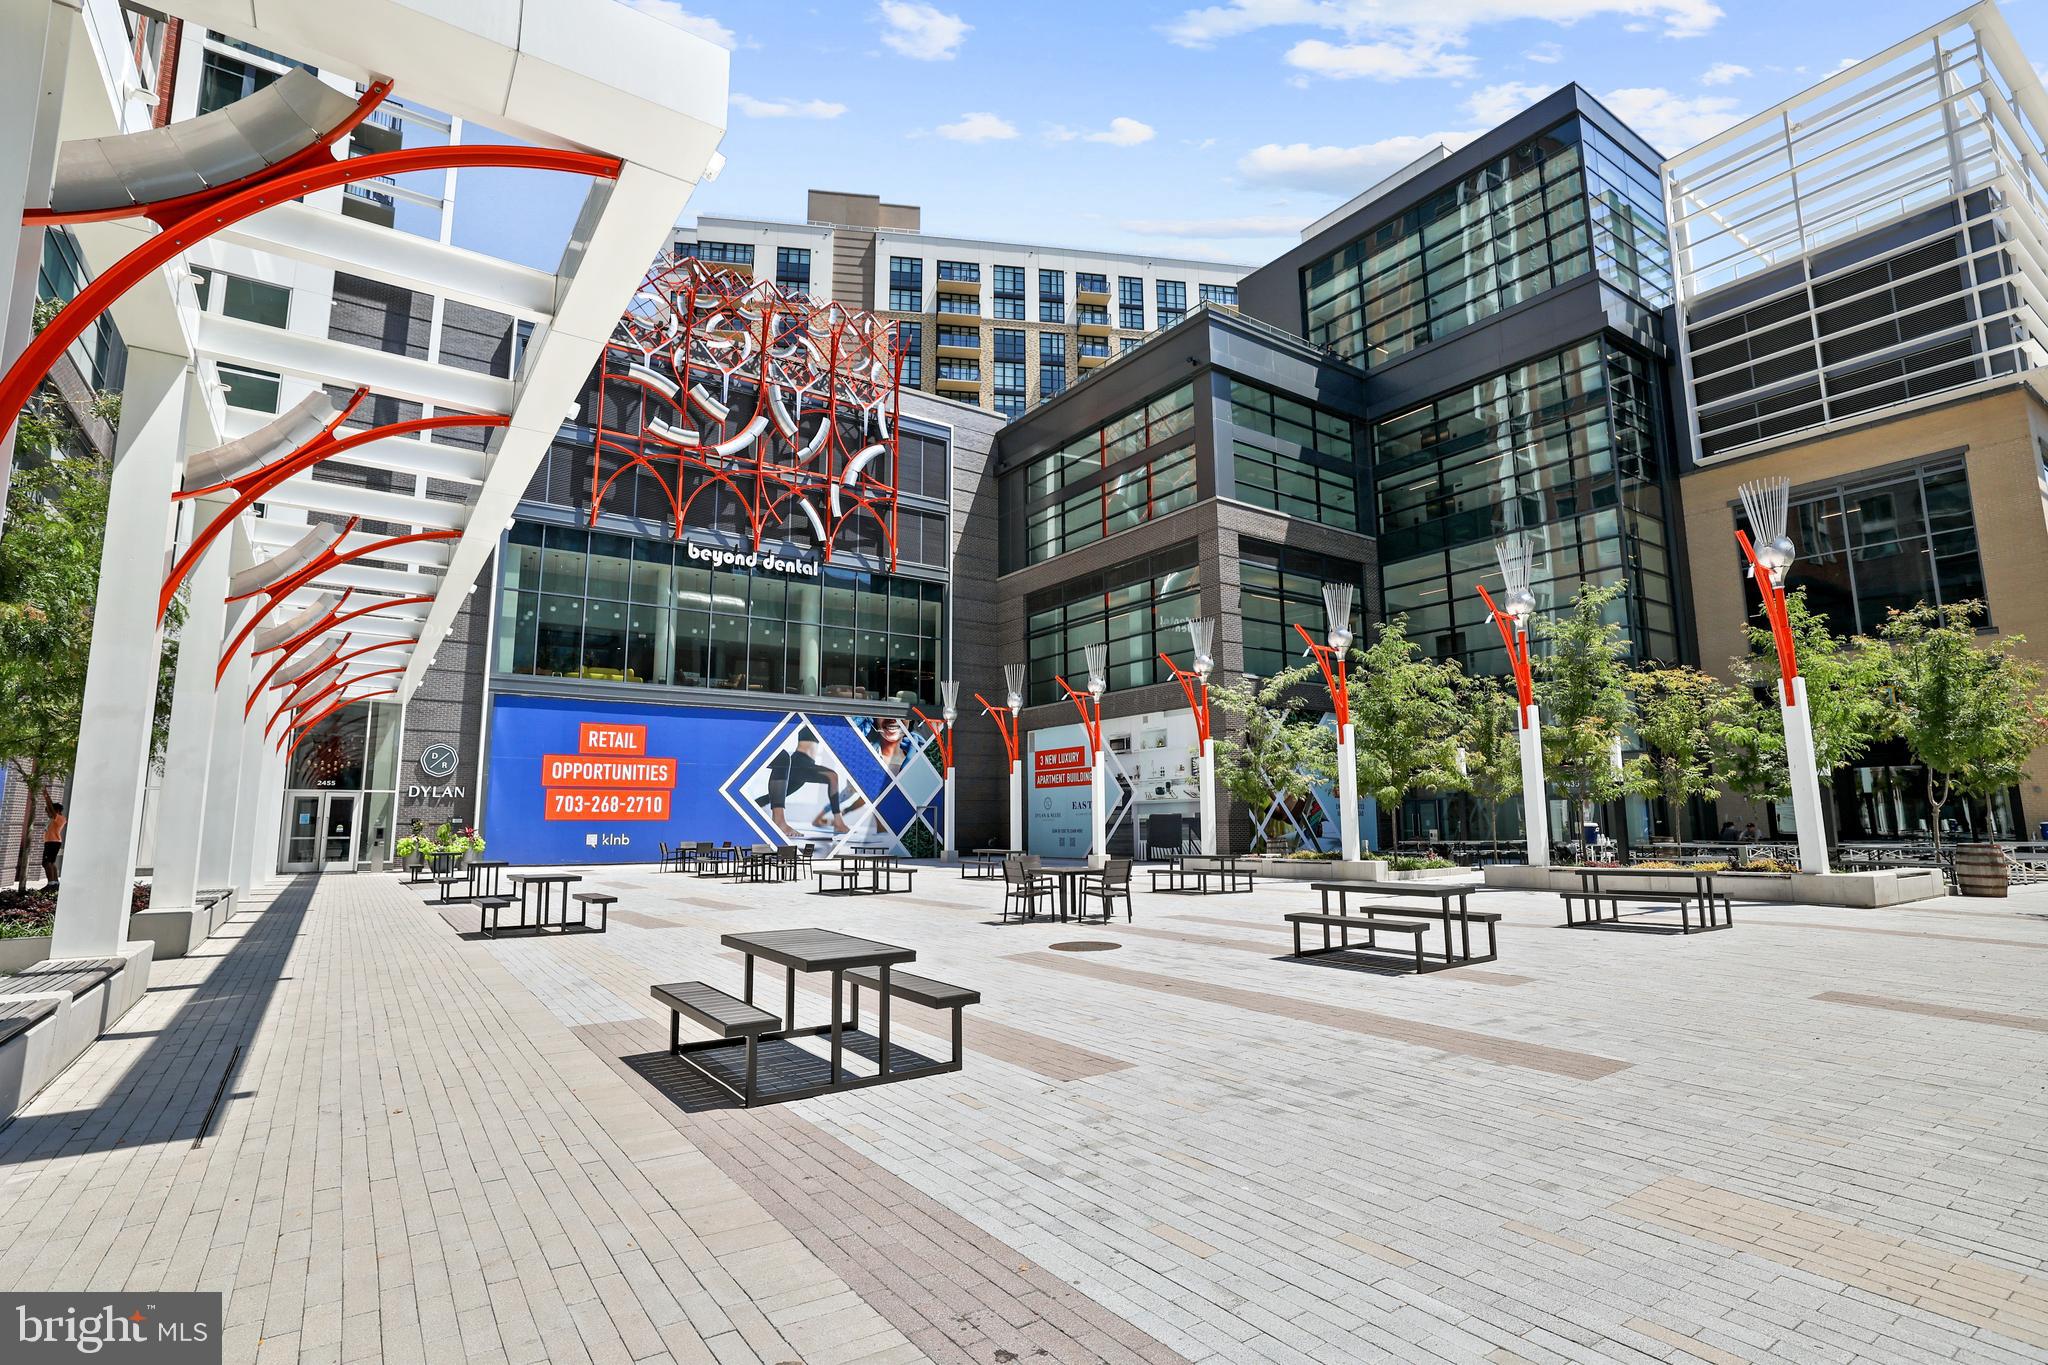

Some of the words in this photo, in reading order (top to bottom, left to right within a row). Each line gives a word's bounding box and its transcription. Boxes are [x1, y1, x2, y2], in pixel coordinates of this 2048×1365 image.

[688, 542, 757, 567] beyond
[763, 554, 818, 576] dental
[588, 730, 638, 749] RETAIL
[1040, 756, 1044, 766] 3
[1045, 754, 1057, 765] NEW
[1058, 752, 1080, 764] LUXURY
[551, 761, 669, 782] OPPORTUNITIES
[1037, 774, 1066, 785] APARTMENT
[408, 785, 465, 798] DYLAN
[555, 795, 663, 814] 703-268-2710
[602, 833, 630, 846] klnb
